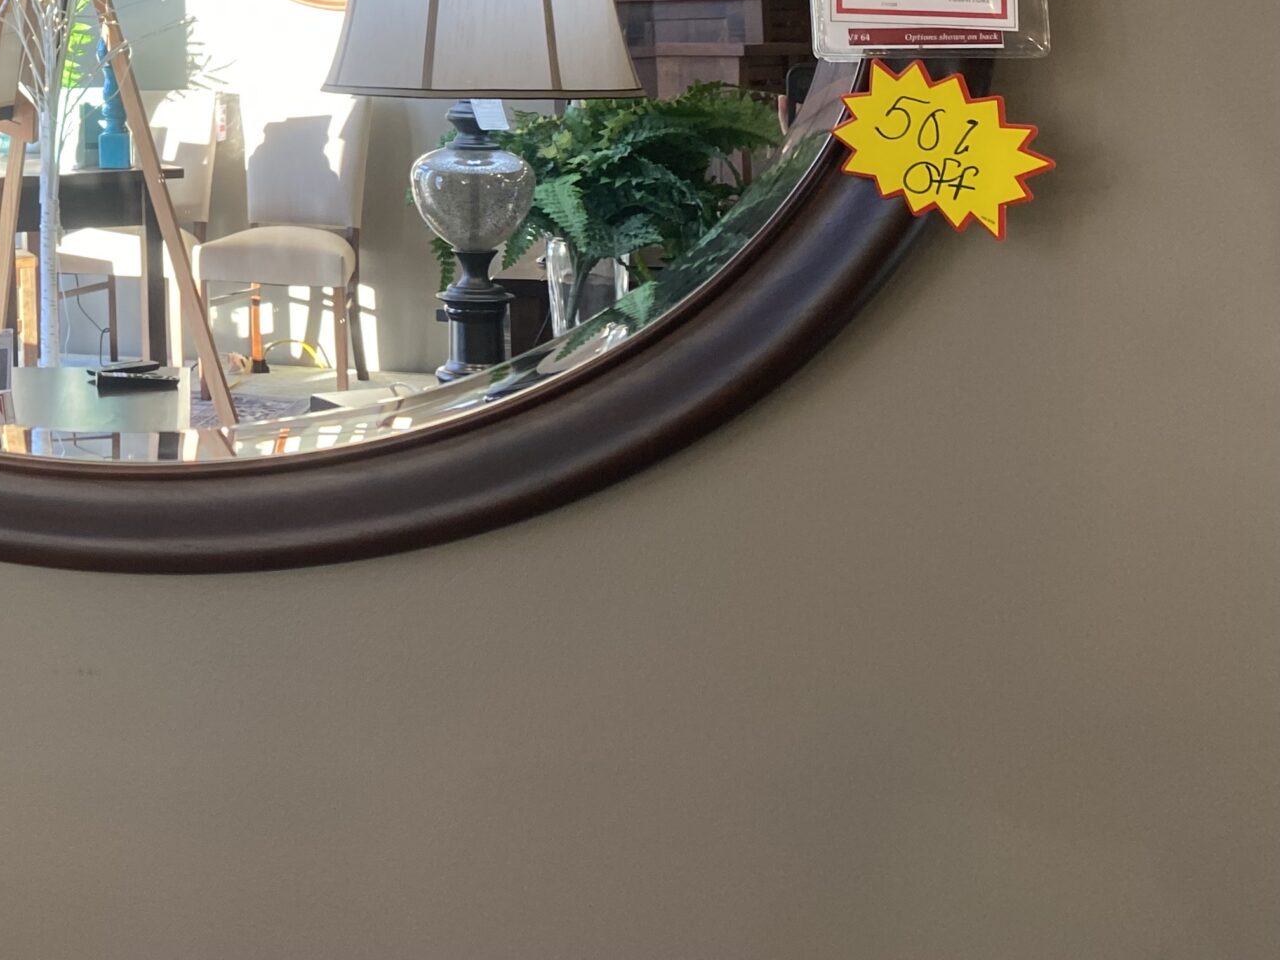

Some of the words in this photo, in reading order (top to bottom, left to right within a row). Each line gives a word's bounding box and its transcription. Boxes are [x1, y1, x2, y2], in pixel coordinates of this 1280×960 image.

[860, 33, 871, 42] 64
[904, 33, 938, 43] Options
[938, 33, 965, 42] shown
[979, 32, 999, 41] back
